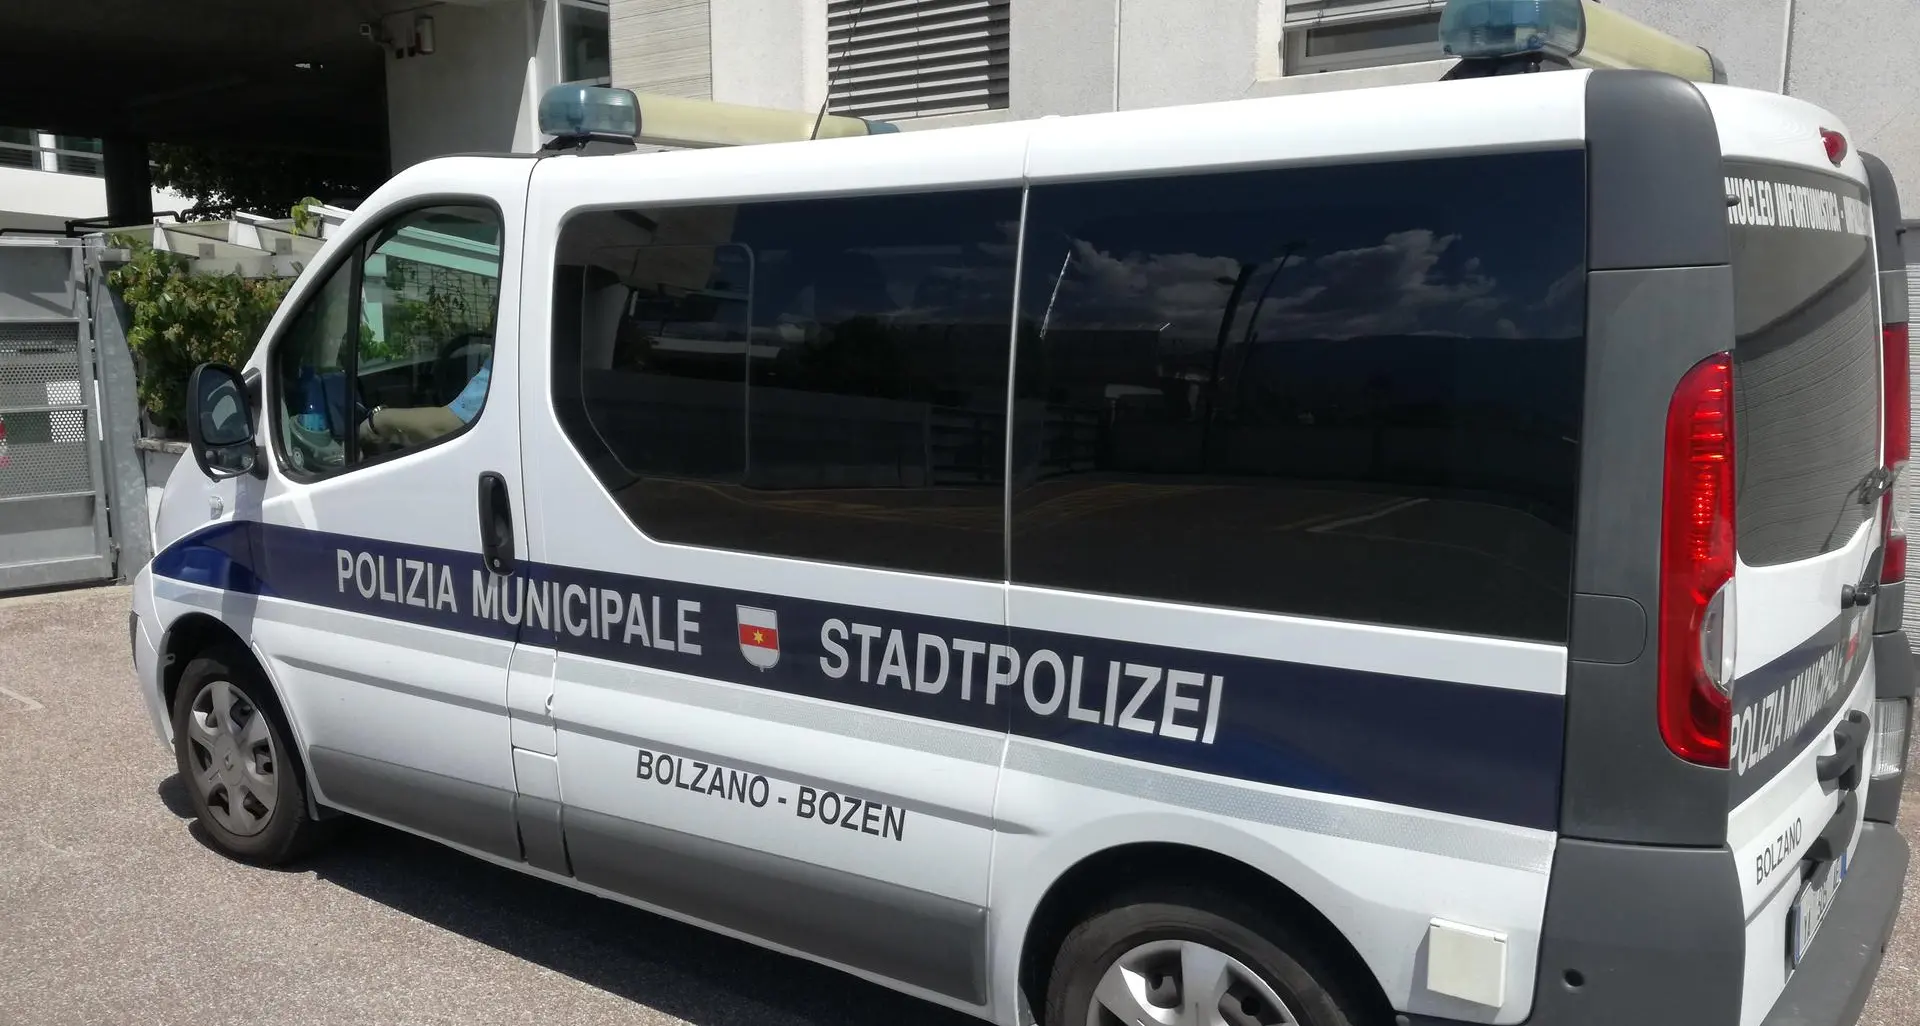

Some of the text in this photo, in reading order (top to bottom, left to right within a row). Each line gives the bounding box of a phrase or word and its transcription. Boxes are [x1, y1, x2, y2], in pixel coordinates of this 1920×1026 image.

[1724, 176, 1775, 226] NUCLEO
[337, 548, 1225, 745] POLIZIA MUNICIPALE STADTPOLIZEI
[1732, 684, 1786, 777] POLIZIA
[636, 749, 770, 808] BOLZANO
[796, 785, 906, 842] BOZEN
[1756, 817, 1802, 886] BOLZANO
